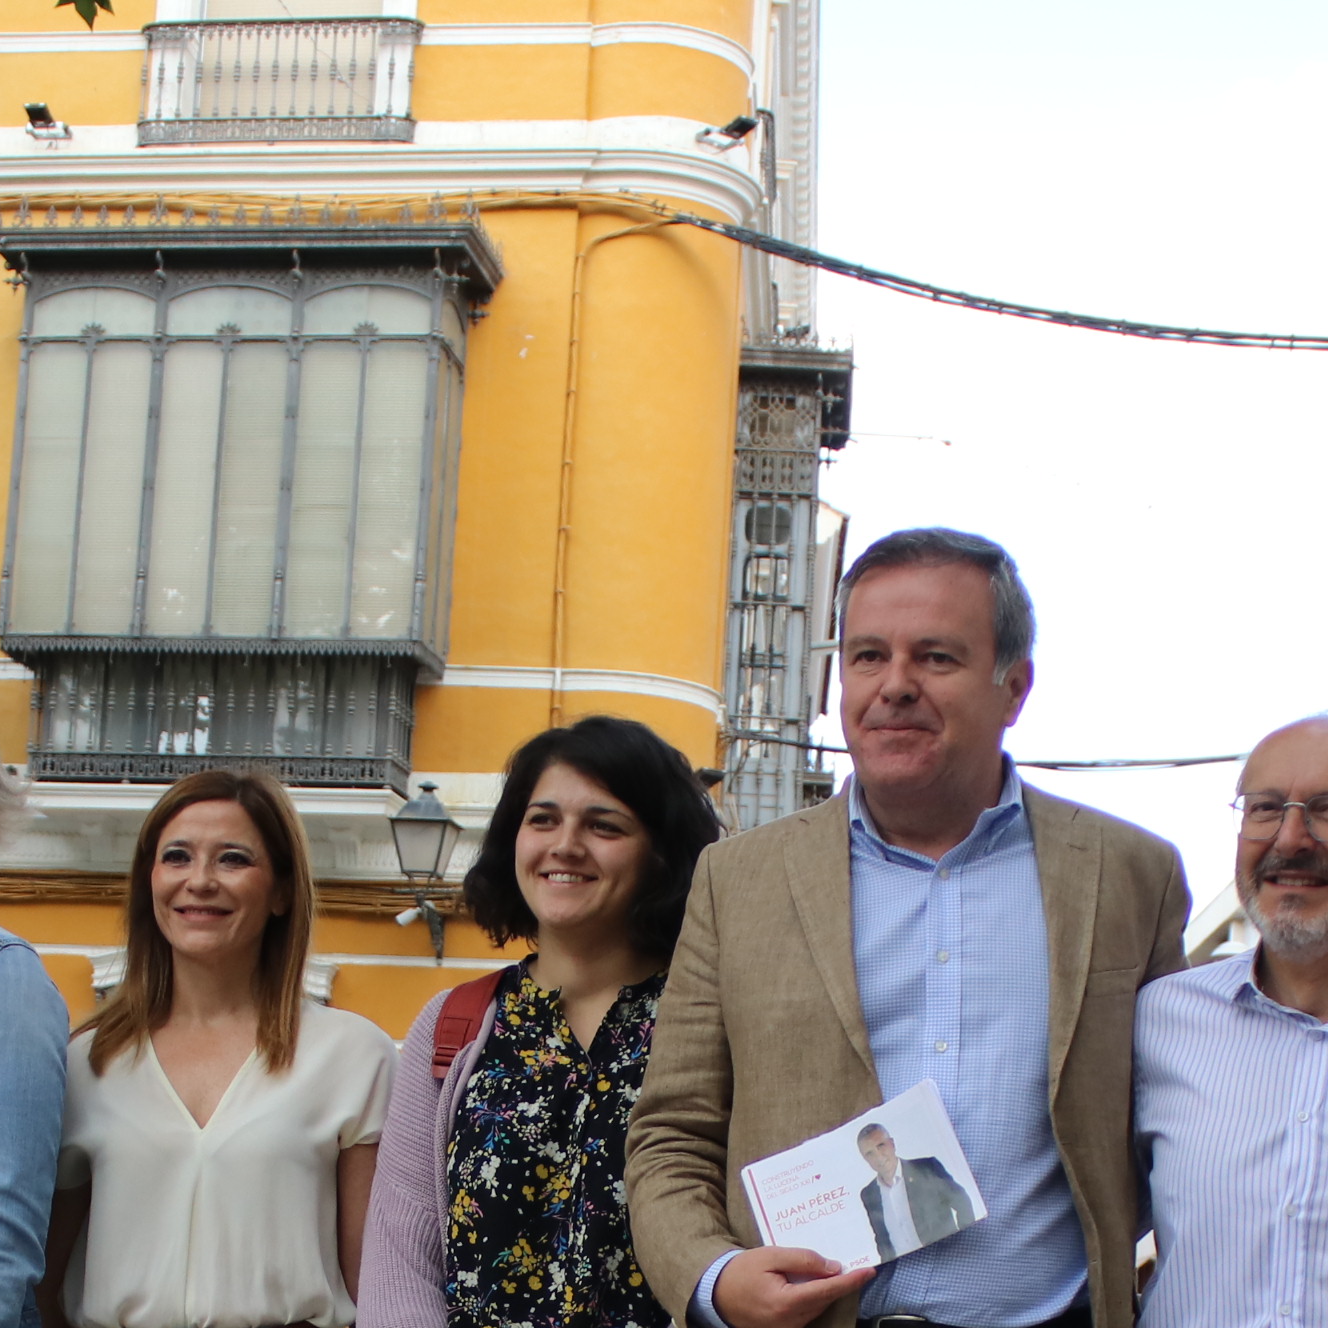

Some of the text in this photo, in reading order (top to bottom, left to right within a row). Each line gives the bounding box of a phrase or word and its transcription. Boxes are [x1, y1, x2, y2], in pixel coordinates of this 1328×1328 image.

[775, 1202, 807, 1222] JUAN
[777, 1199, 846, 1233] TU ALCALDE
[849, 1255, 871, 1268] PSOE
